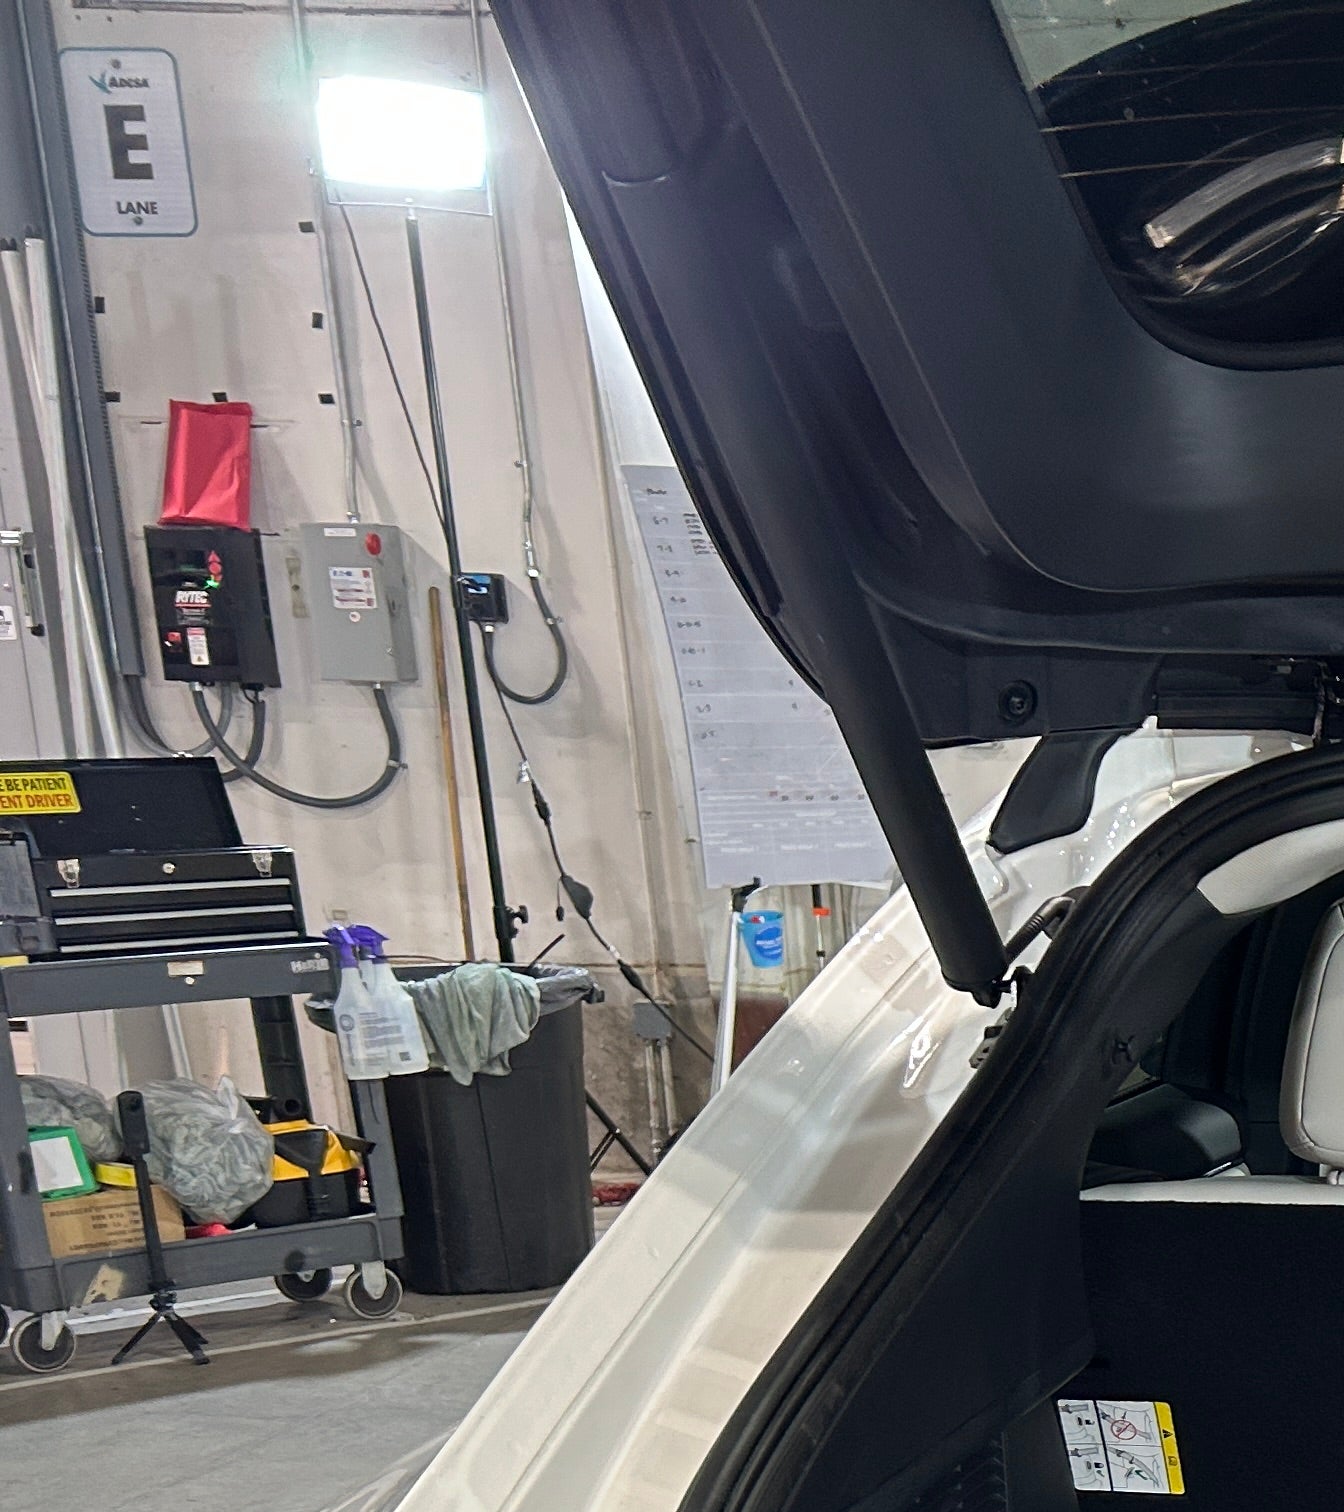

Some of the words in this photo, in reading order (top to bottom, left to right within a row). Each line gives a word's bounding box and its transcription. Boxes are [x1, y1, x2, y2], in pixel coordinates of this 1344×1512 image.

[103, 104, 154, 179] E
[116, 201, 158, 214] LANE
[175, 590, 209, 603] RYTEC
[5, 778, 22, 791] BE
[22, 777, 67, 791] PATIENT
[25, 794, 74, 808] DRIVER
